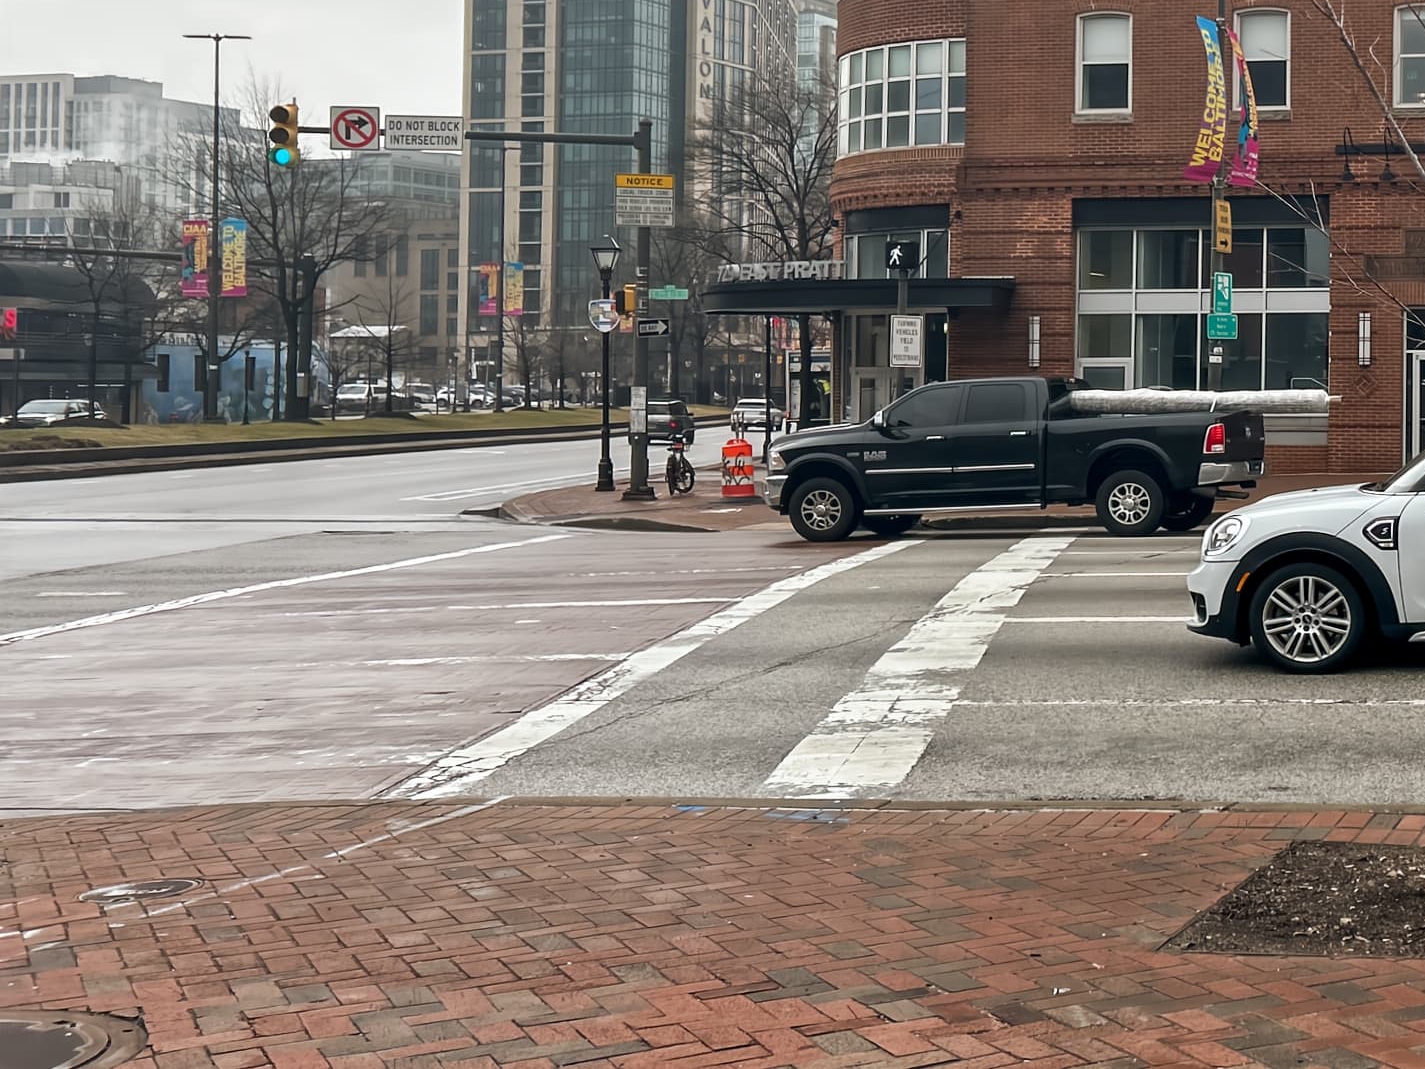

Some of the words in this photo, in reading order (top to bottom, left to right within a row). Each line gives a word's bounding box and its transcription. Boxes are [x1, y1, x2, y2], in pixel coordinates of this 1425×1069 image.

[1208, 43, 1227, 162] BALTIMORE
[1190, 63, 1217, 166] WELCOME
[389, 121, 401, 130] DO
[406, 121, 424, 130] NOT
[428, 121, 460, 131] BLOCK
[390, 135, 458, 145] INTERSECTION
[626, 178, 664, 186] NOTICE
[222, 243, 234, 291] WELCOME
[783, 260, 845, 280] PRATT
